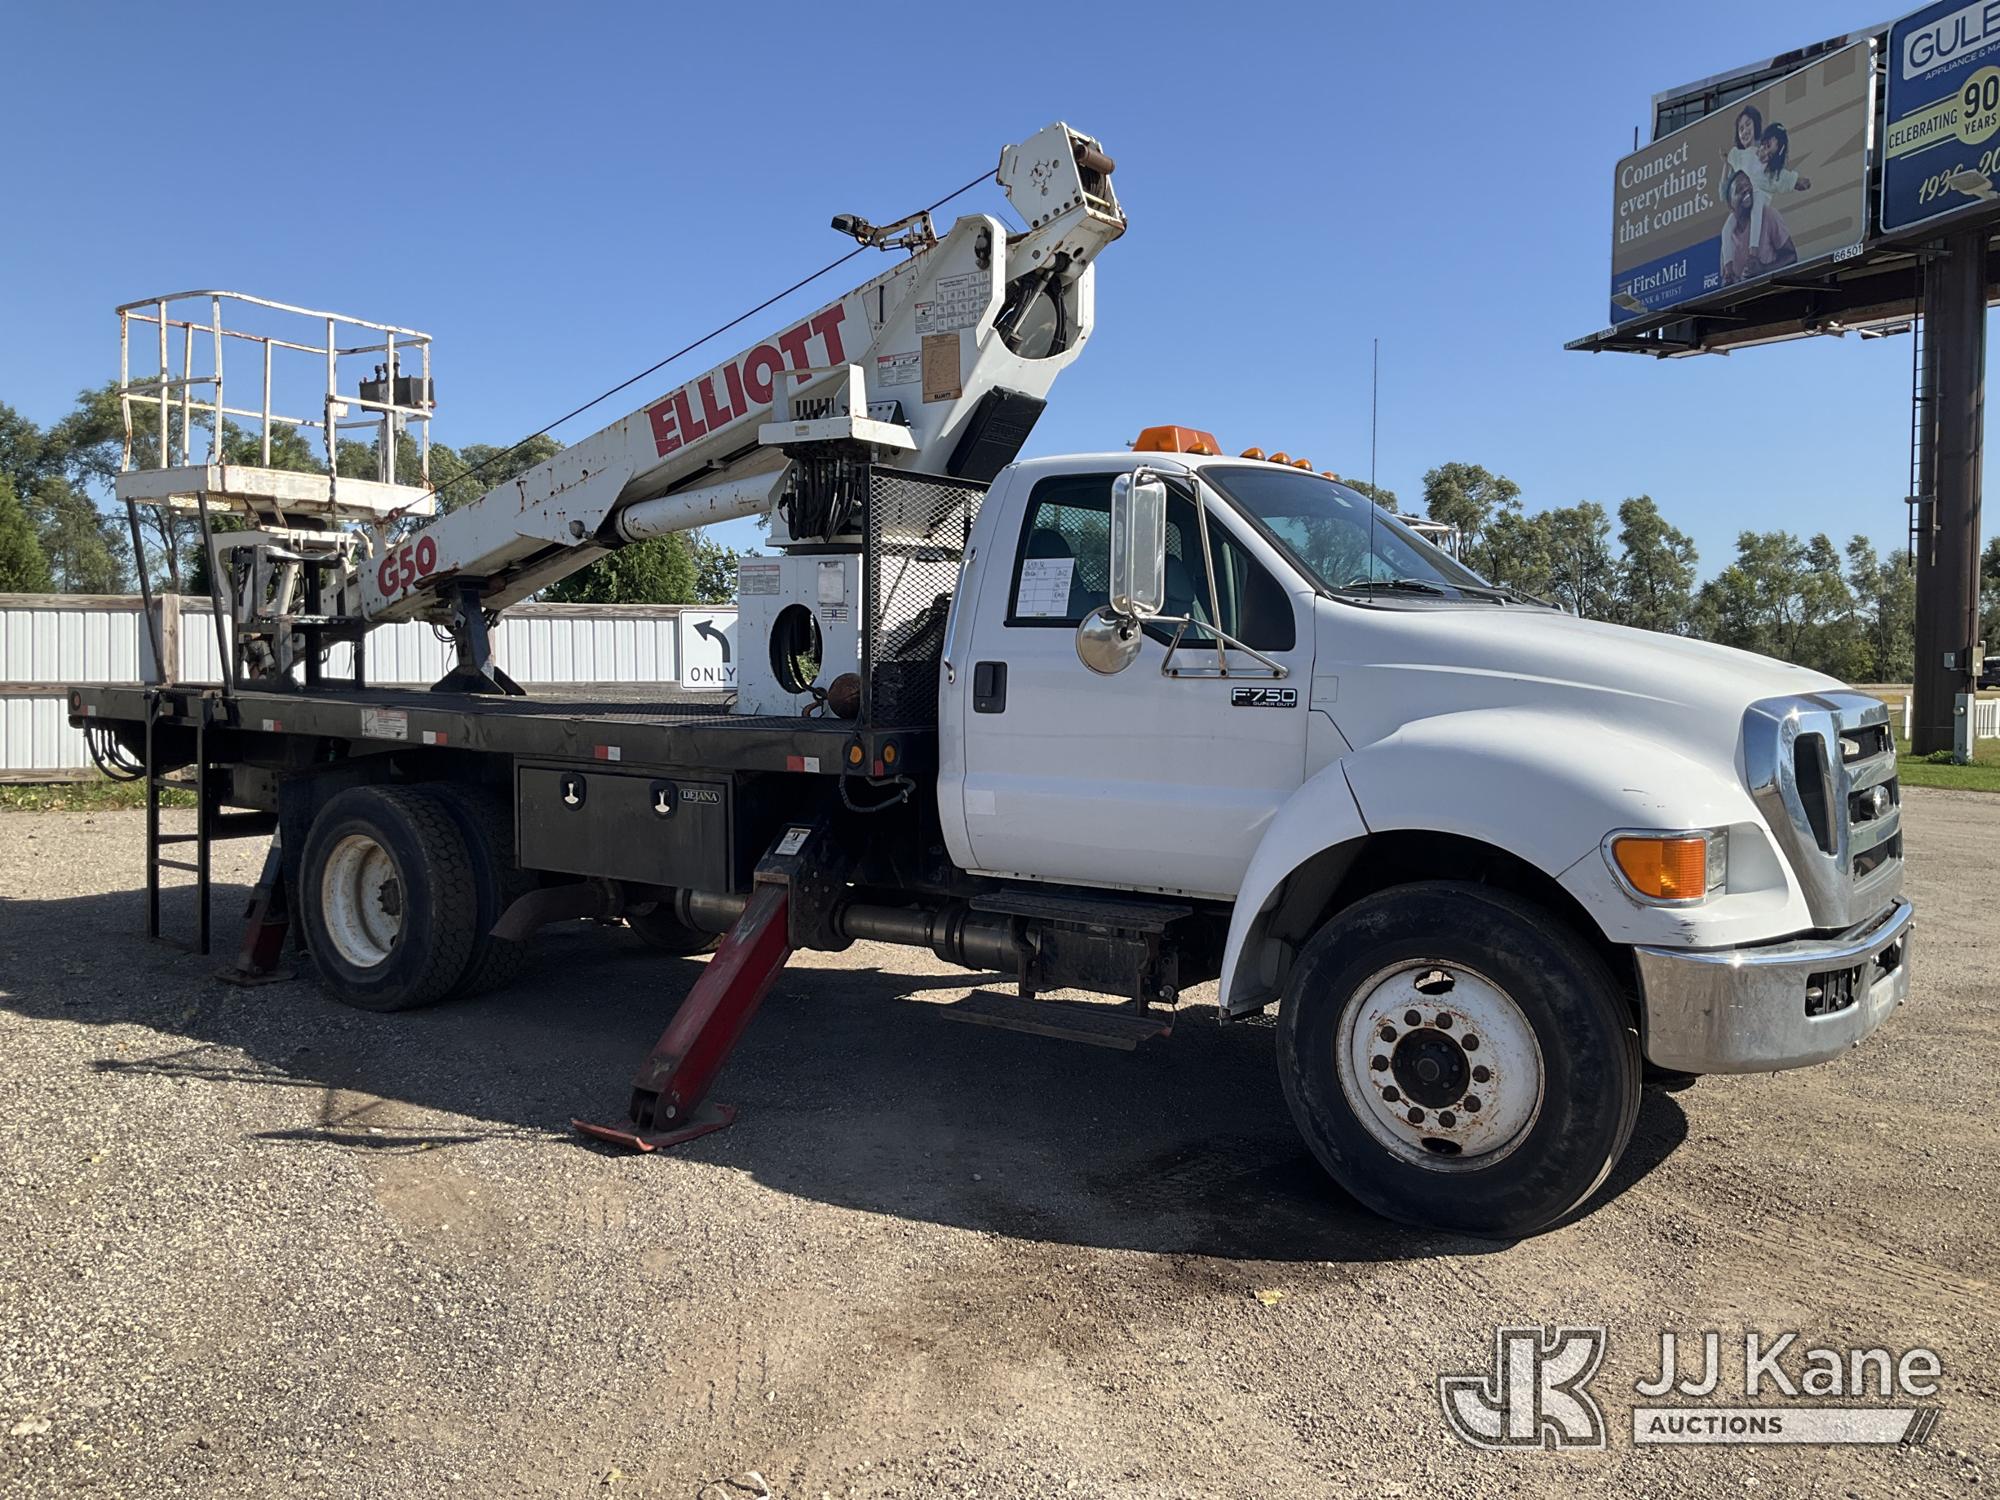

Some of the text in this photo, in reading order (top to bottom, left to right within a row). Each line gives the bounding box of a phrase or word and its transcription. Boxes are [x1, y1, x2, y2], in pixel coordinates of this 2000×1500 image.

[1925, 53, 1977, 80] APPLIANCE
[1978, 49, 1986, 58] &
[1888, 75, 1999, 149] CELEBRATING 90
[1964, 112, 1997, 135] YEARS
[1621, 141, 1688, 189] Connect
[1620, 165, 1708, 216] everything
[1620, 193, 1714, 243] that counts.
[1834, 244, 1862, 261] 66501
[1633, 259, 1719, 294] First Mid FDIC
[1661, 286, 1682, 301] TRUST
[648, 303, 846, 458] ELLIOTT
[378, 536, 436, 597] G50
[691, 667, 736, 681] ONLY
[683, 791, 717, 802] DEJANA
